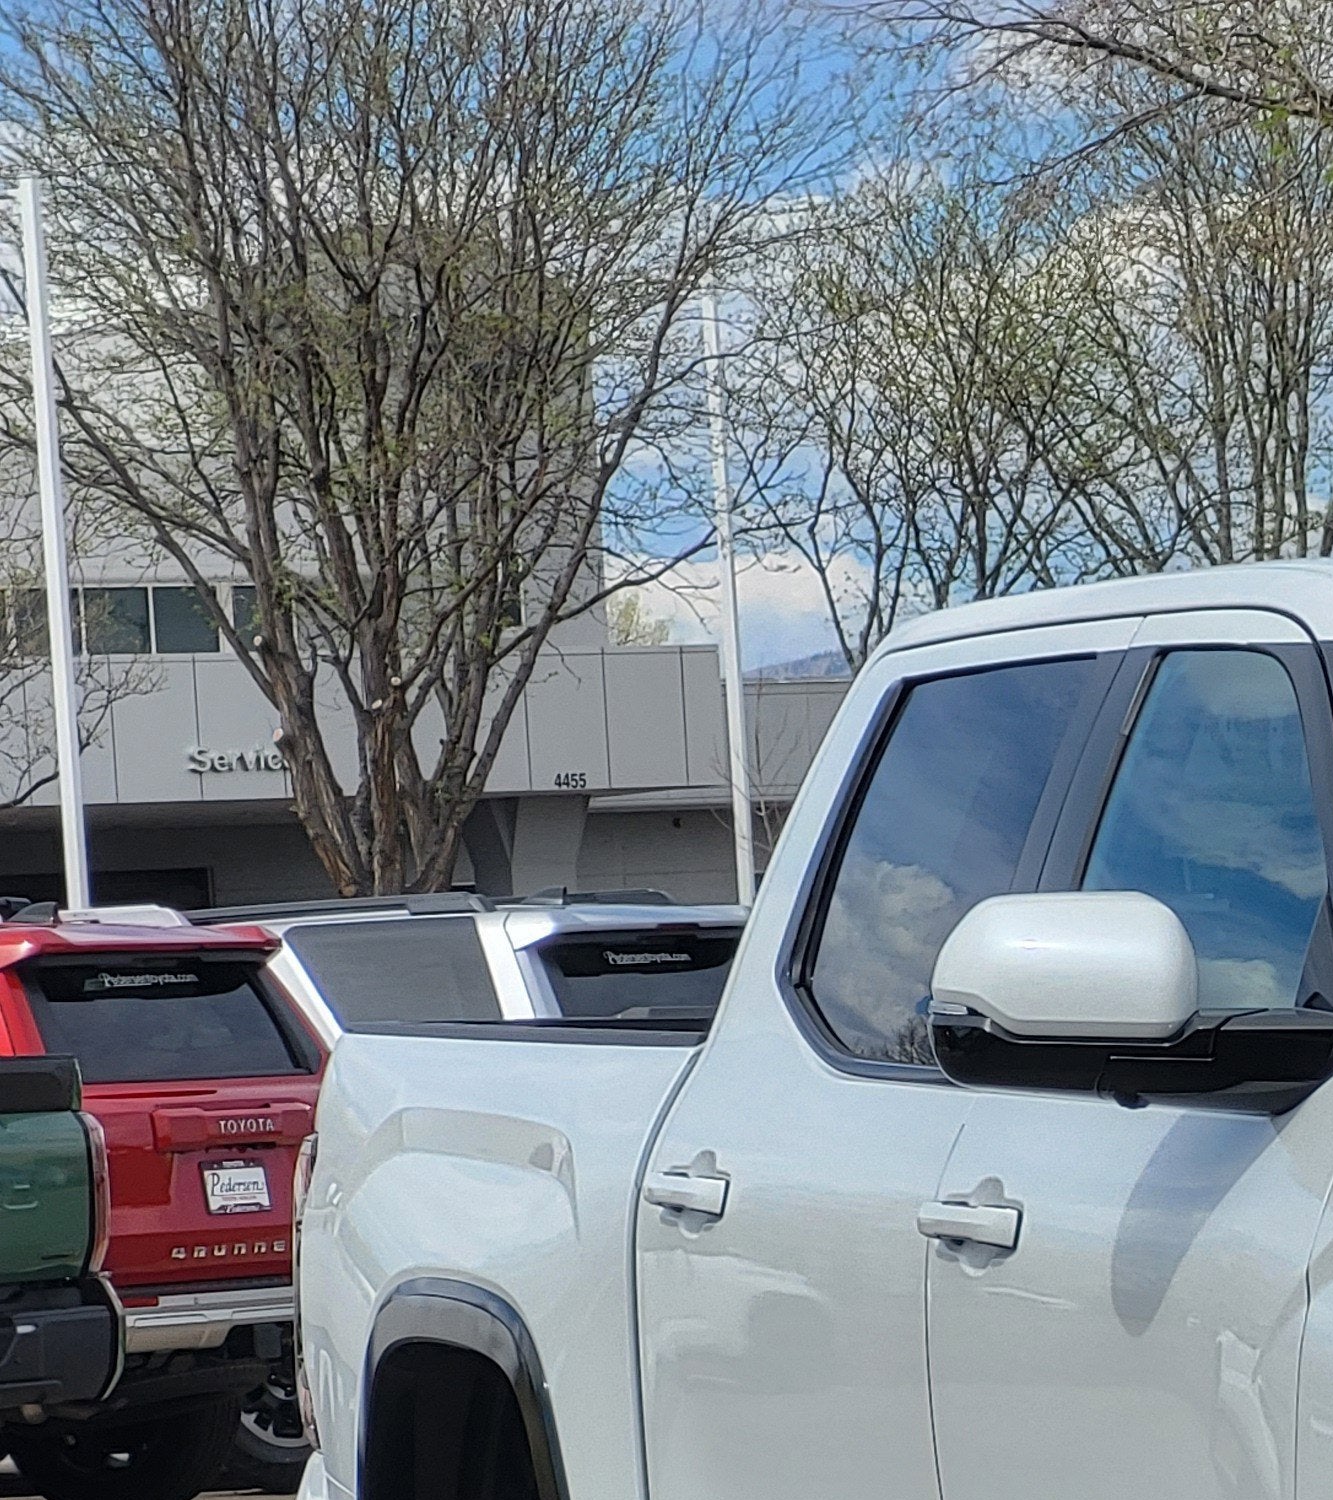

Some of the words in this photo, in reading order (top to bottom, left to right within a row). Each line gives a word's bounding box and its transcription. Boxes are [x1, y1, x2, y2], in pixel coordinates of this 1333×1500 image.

[187, 744, 291, 772] Servic
[554, 772, 587, 789] 4455
[218, 1118, 275, 1134] TOYOTA
[207, 1172, 265, 1197] Pedersen
[170, 1240, 287, 1260] 4RUNNE
